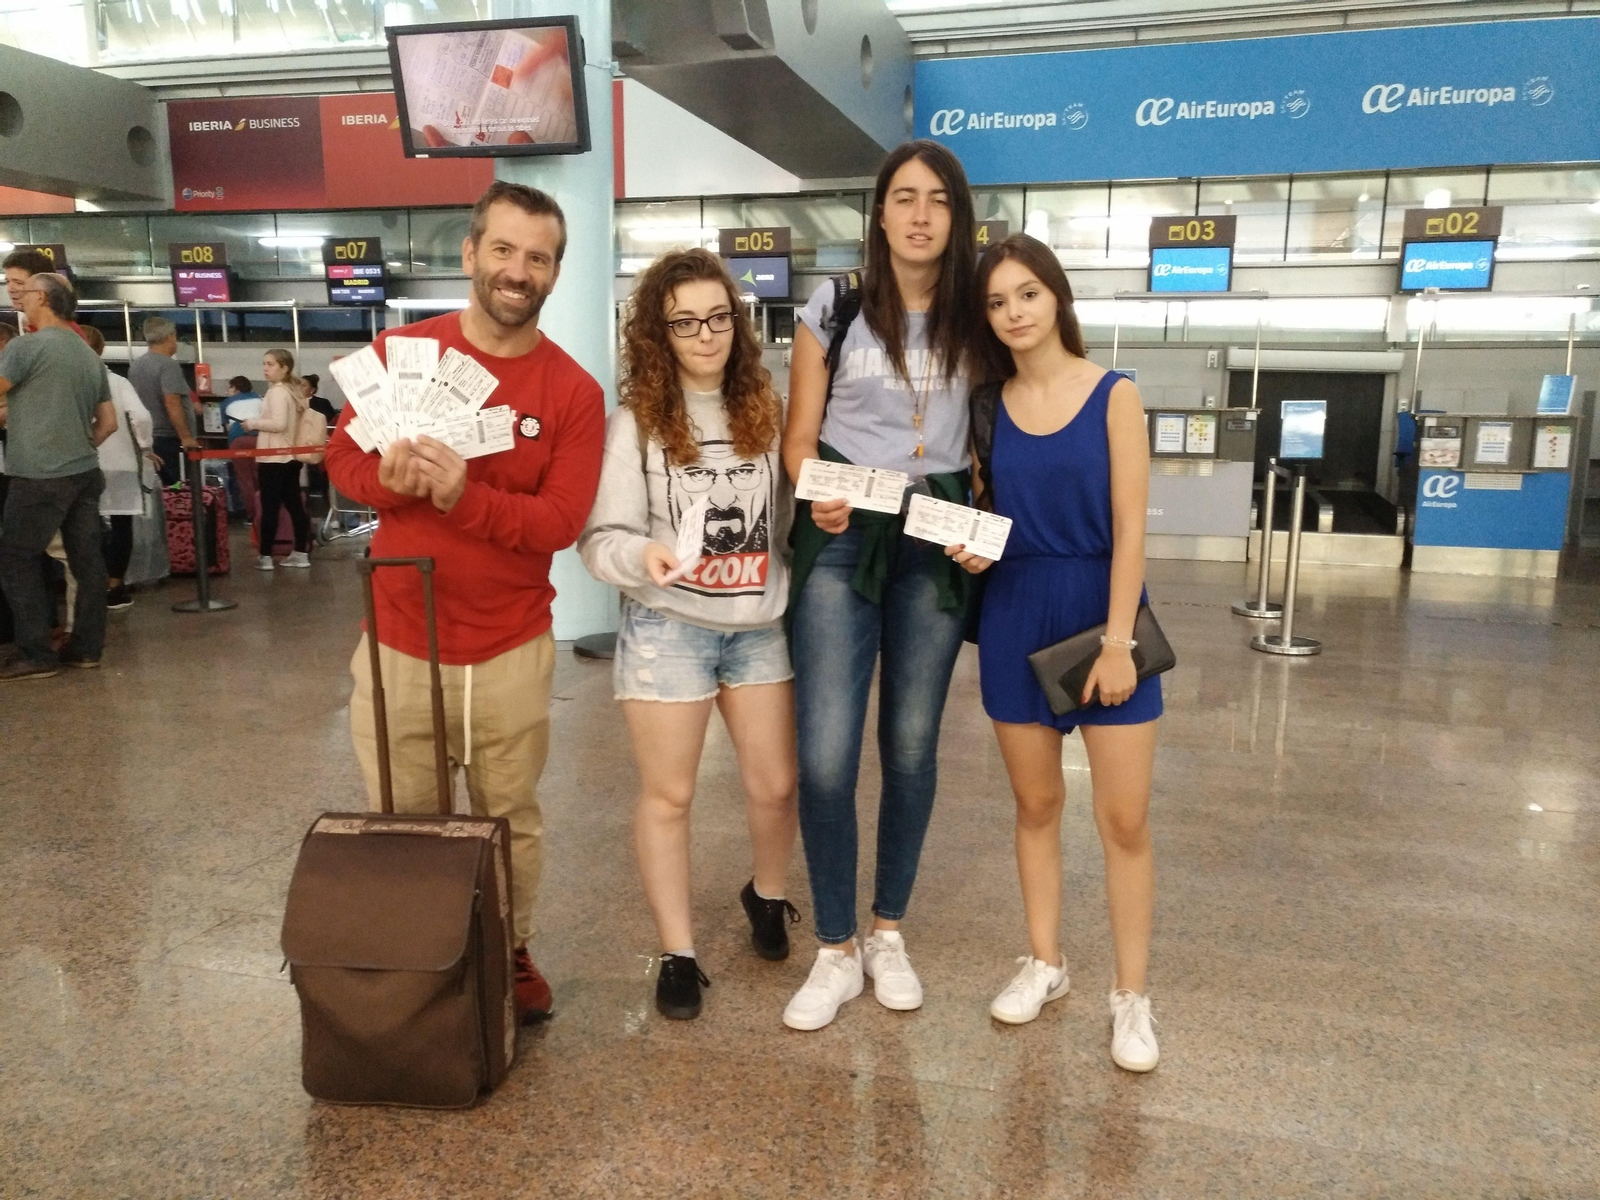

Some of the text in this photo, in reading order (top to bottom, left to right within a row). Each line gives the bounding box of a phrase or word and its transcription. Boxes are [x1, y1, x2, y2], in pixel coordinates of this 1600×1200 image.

[1406, 85, 1516, 107] AirEuropa
[341, 113, 388, 126] IBERIA
[1175, 100, 1275, 120] AirEuropa
[188, 117, 300, 132] IBERIA BUSINESS
[966, 111, 1057, 131] AirEuropa
[1186, 220, 1216, 241] 03
[1446, 211, 1479, 235] 02
[750, 231, 774, 251] 05
[976, 225, 990, 245] 4
[193, 245, 214, 263] 08
[346, 241, 367, 259] 07
[683, 555, 766, 586] COOK
